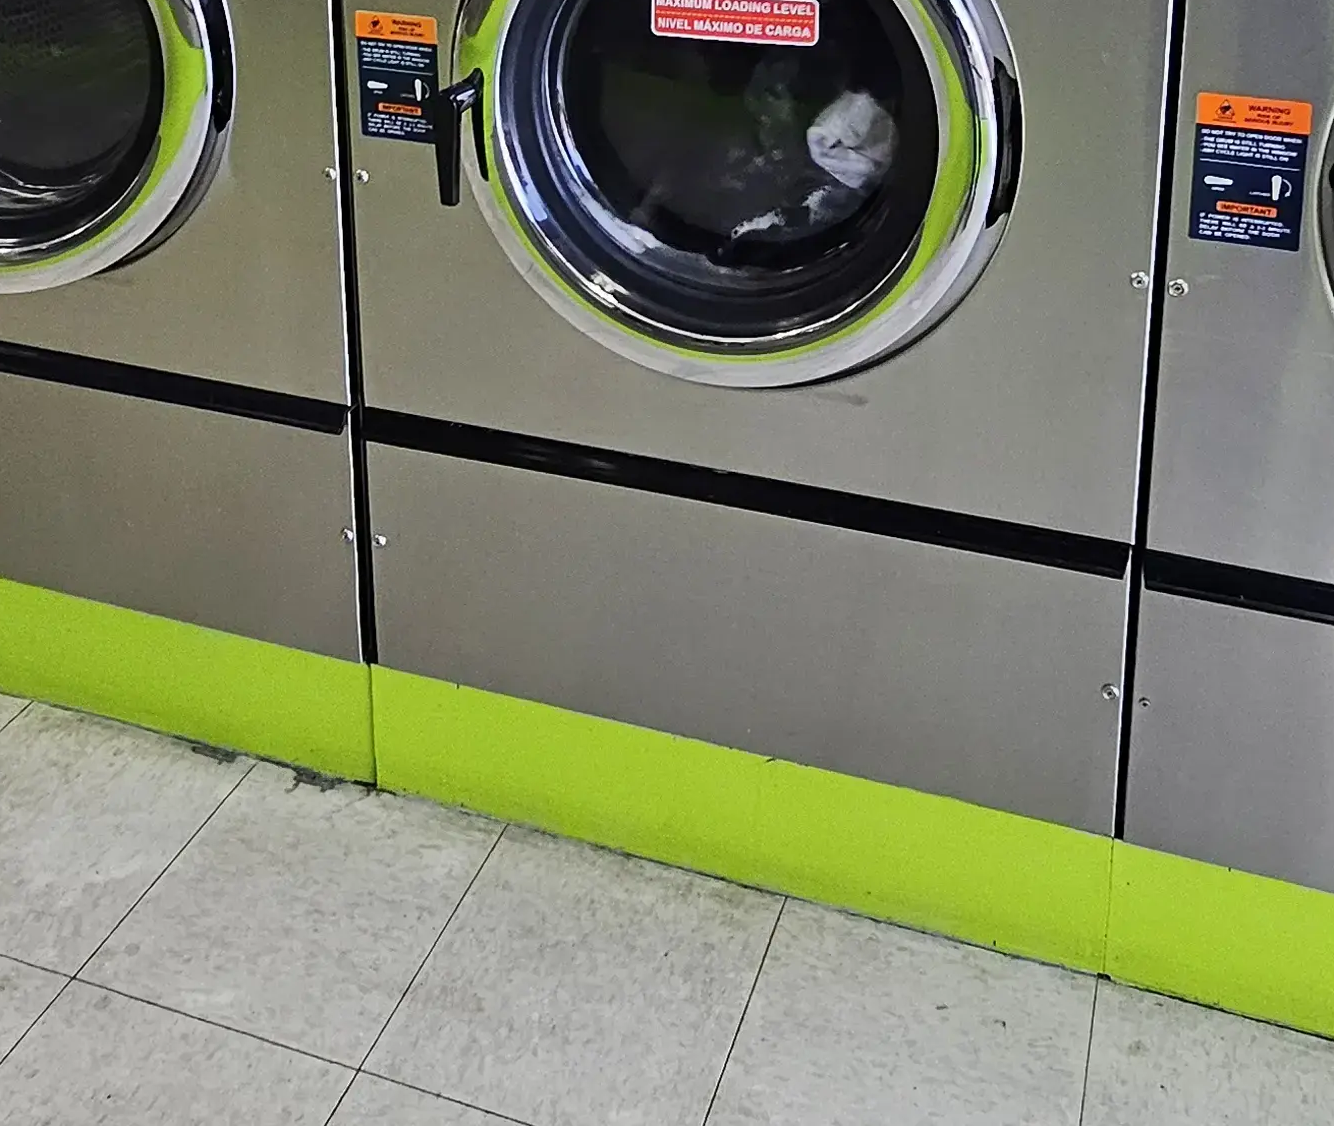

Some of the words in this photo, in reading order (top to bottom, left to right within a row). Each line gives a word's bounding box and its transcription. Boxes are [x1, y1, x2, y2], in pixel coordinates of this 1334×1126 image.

[714, 0, 771, 14] LOADING
[773, 2, 815, 16] LEVEL
[657, 16, 691, 31] NIVEL
[693, 18, 743, 34] MÁXIMO
[745, 24, 763, 36] DE
[765, 24, 812, 38] CARGA
[1248, 105, 1291, 116] WARNING
[1221, 202, 1273, 216] IMPORTANT
